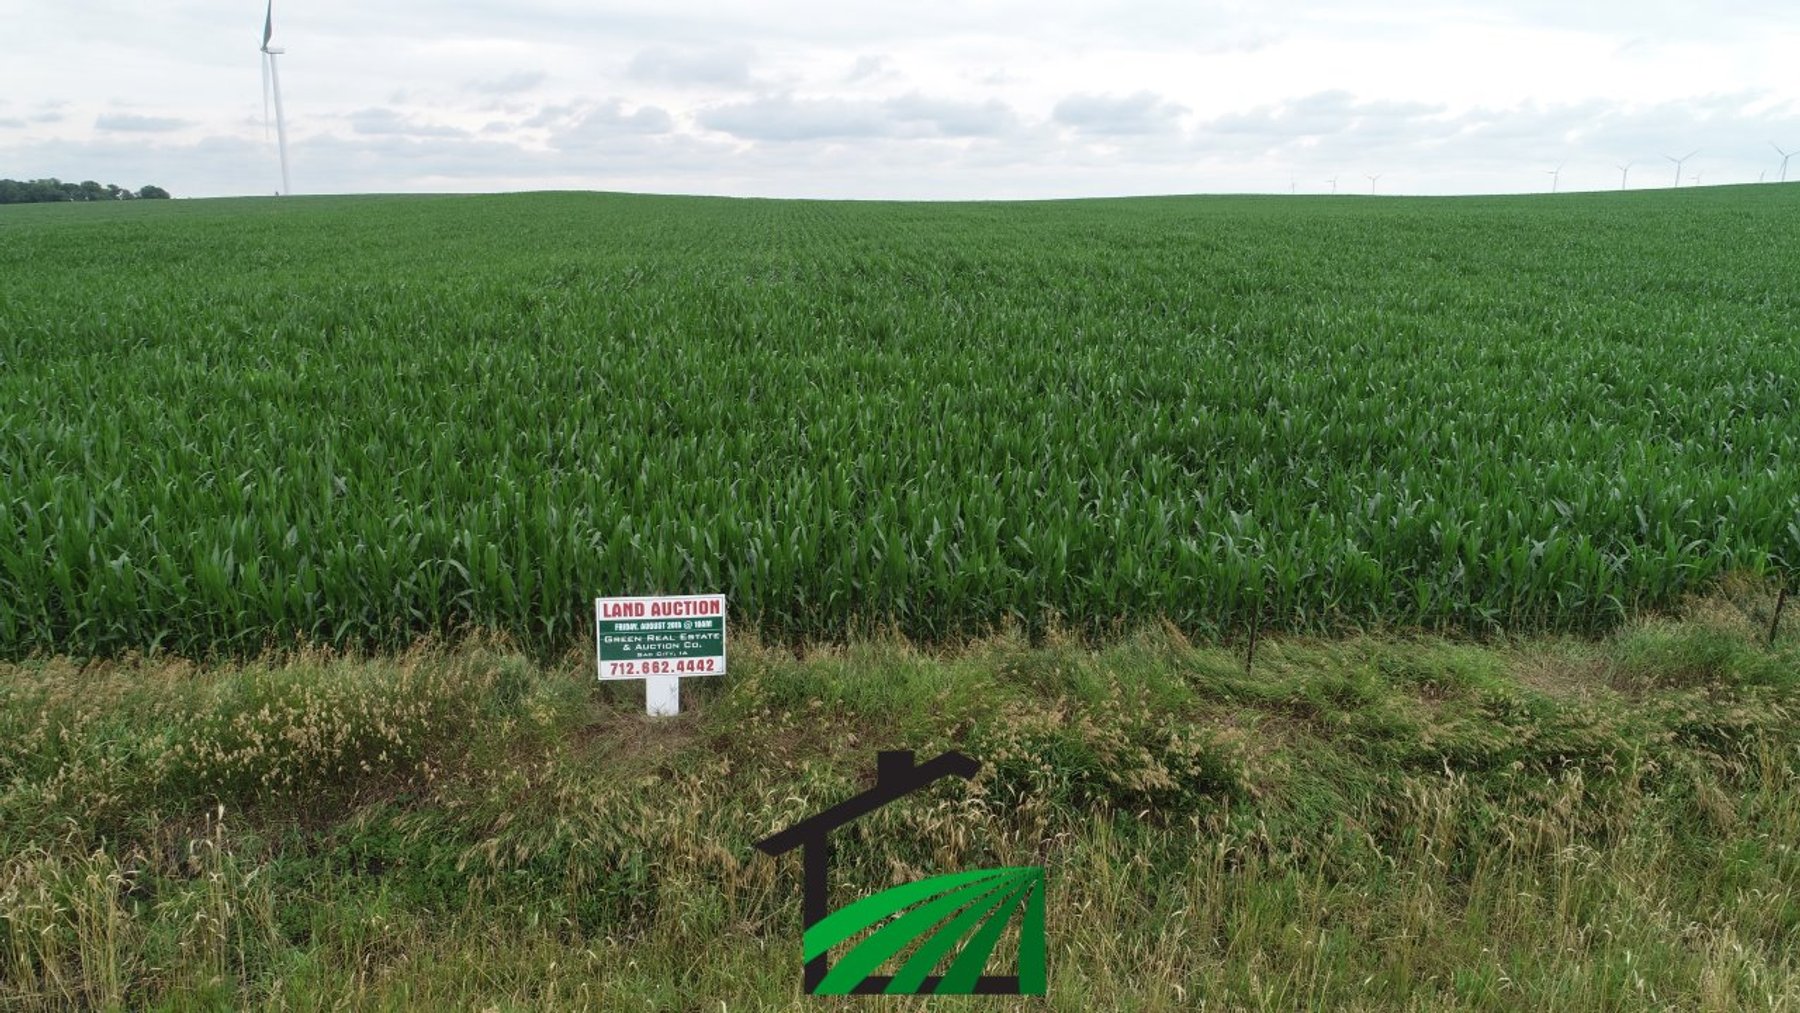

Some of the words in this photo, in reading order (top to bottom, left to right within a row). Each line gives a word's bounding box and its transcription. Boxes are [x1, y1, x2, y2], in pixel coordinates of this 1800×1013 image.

[603, 602, 644, 618] LAND
[651, 600, 720, 616] AUCTION
[684, 621, 693, 629] @
[610, 659, 714, 675] 712.662.4442
